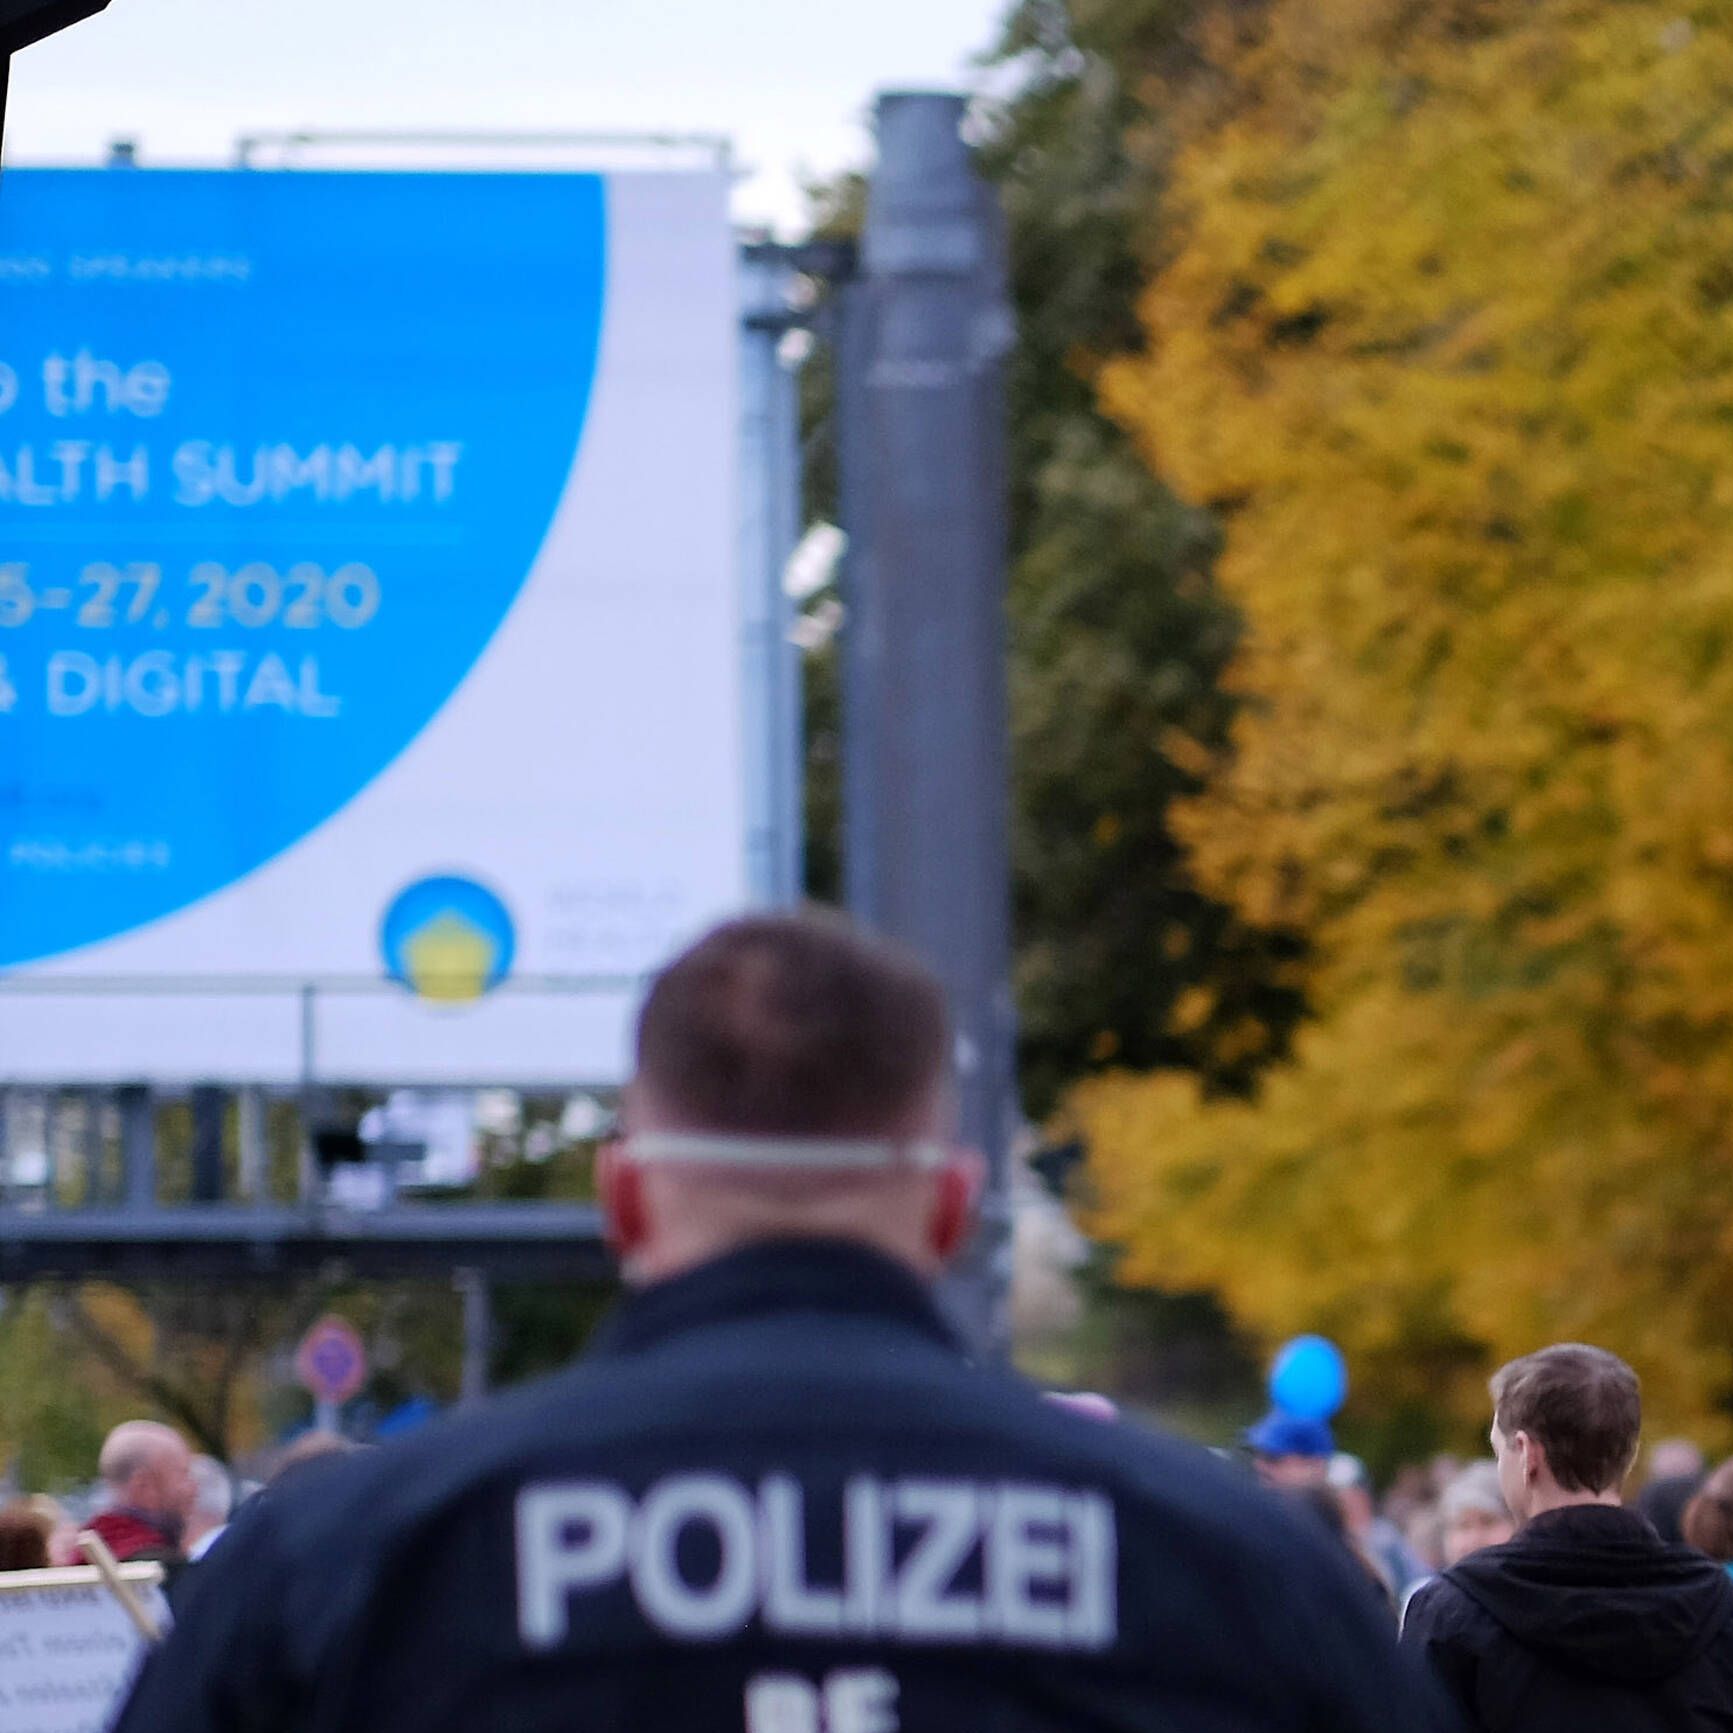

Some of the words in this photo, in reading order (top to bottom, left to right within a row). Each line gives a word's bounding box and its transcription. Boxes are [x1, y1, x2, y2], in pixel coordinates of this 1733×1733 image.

[42, 345, 172, 418] the
[172, 439, 463, 506] SUMMIT
[186, 561, 381, 630] 2020
[46, 650, 341, 717] DIGITAL
[515, 1471, 1118, 1650] POLIZEI
